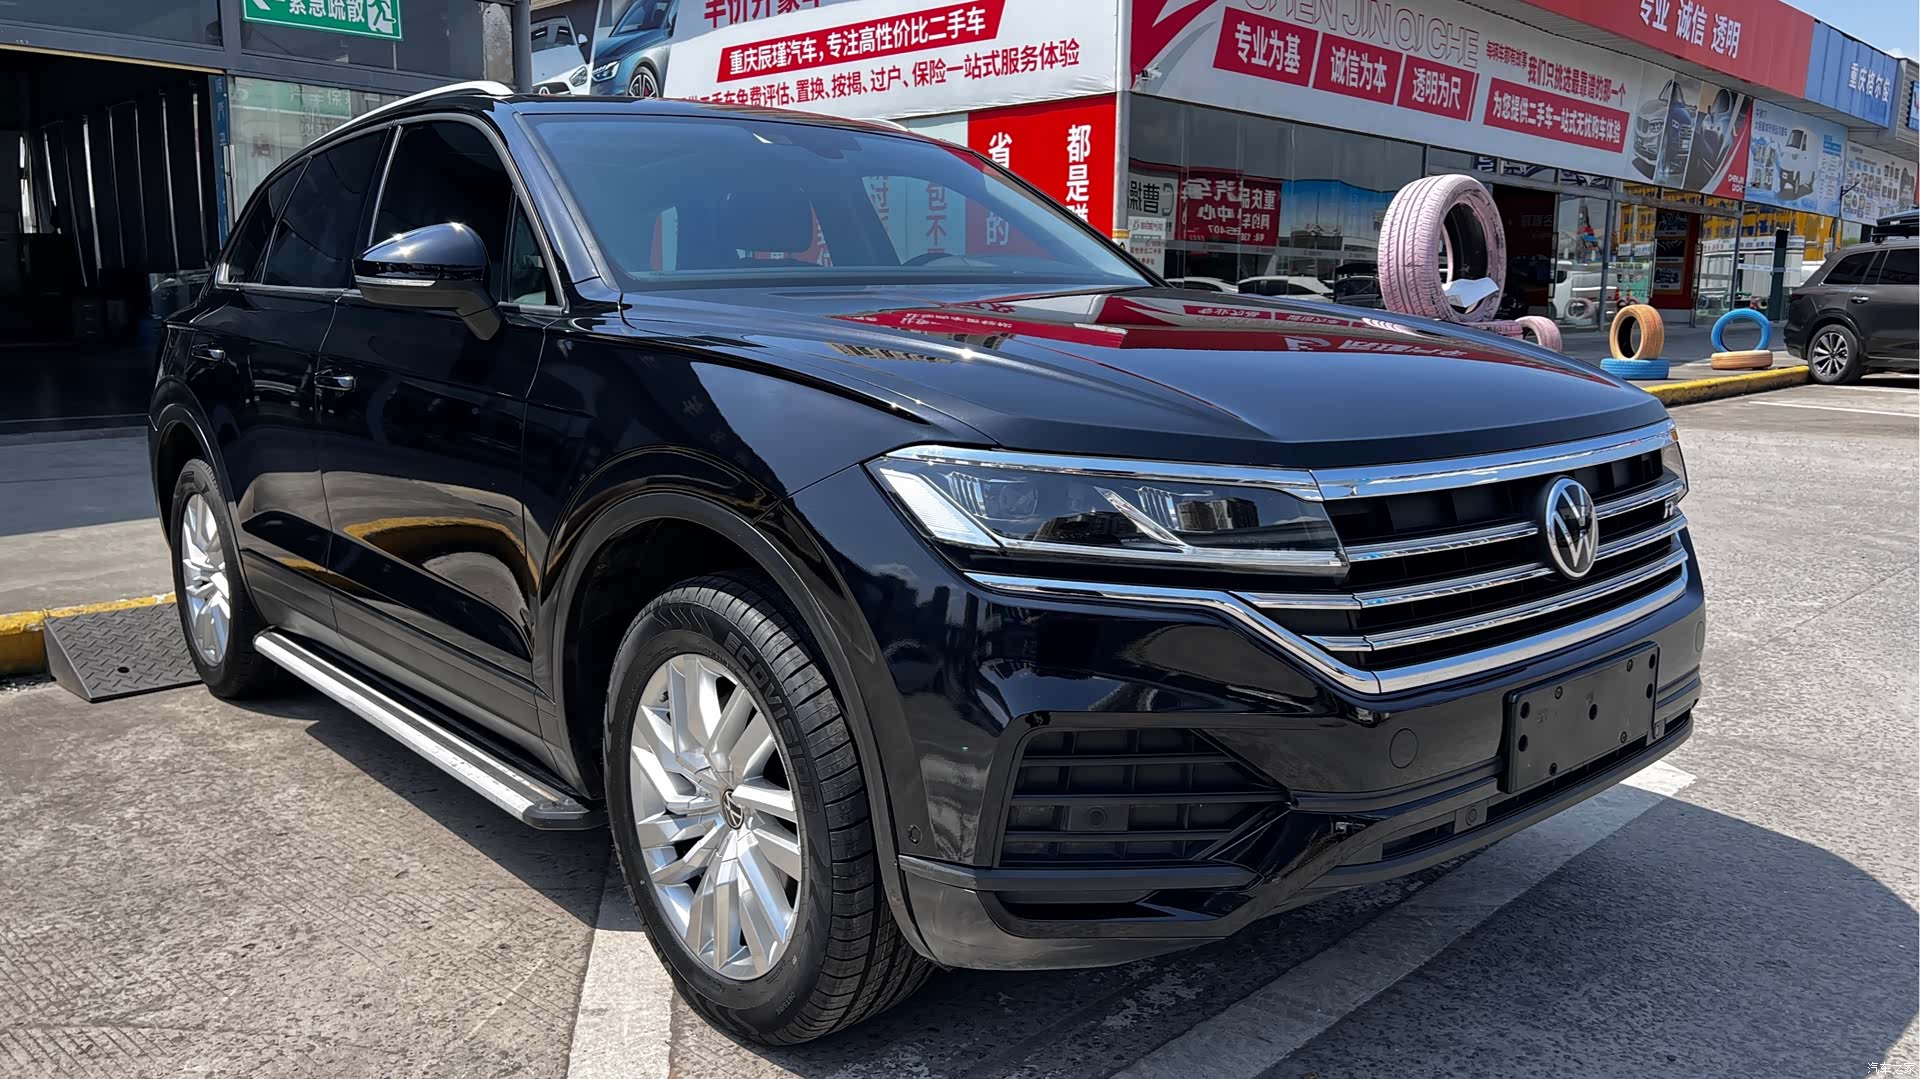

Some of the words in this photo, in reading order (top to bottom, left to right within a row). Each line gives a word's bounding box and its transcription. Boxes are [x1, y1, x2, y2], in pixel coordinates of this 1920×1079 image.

[1234, 21, 1300, 74] 专业为基
[1675, 0, 1708, 46] 诚信
[1710, 13, 1741, 59] 透明
[1330, 46, 1387, 94] 诚信为本
[1412, 67, 1461, 110] 透明为尺
